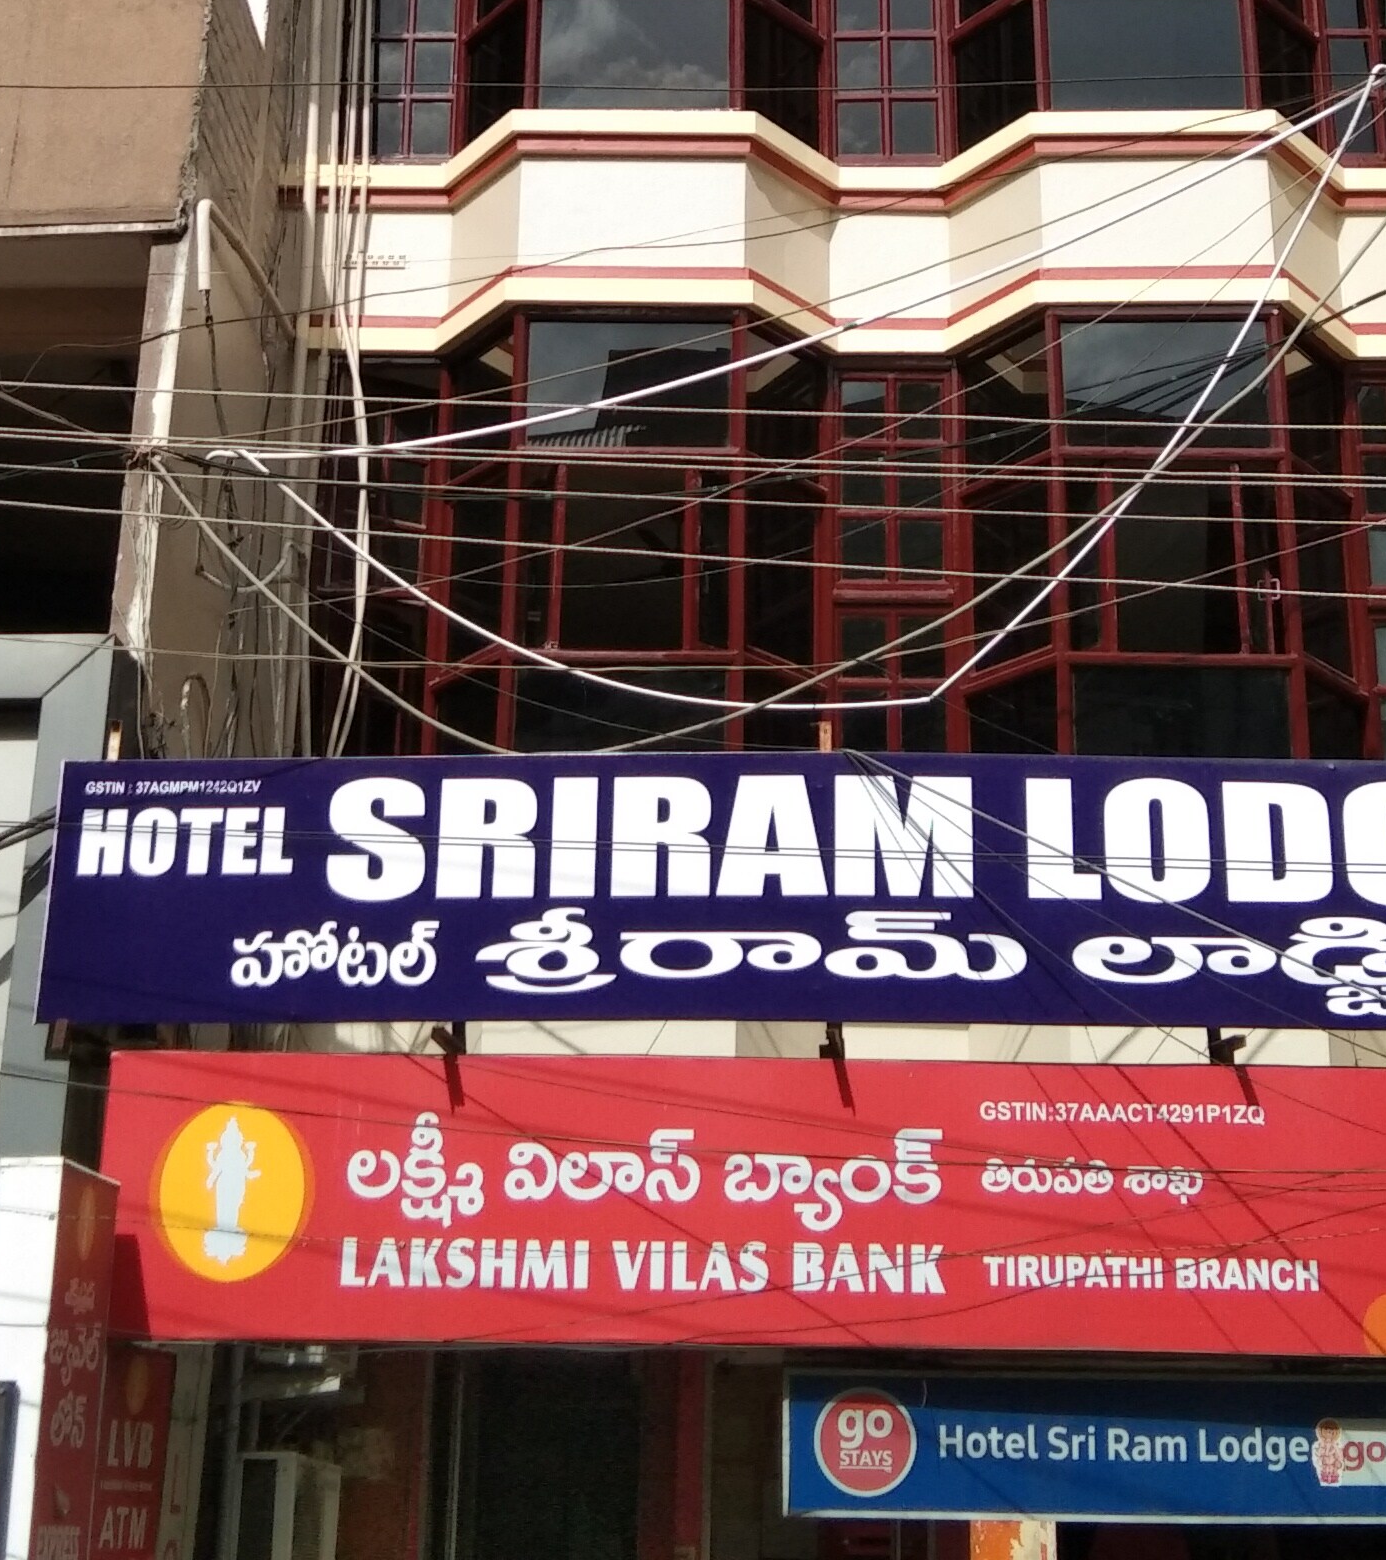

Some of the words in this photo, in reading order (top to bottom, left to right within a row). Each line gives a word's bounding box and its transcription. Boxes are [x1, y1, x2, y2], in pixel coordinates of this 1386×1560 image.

[85, 780, 125, 795] GSTIN
[76, 806, 294, 877] HOTEL
[326, 774, 974, 902] SRIRAM
[339, 1236, 590, 1290] LAKSHMI
[611, 1240, 769, 1292] VILAS
[792, 1242, 946, 1294] BANK
[982, 1255, 1164, 1289] TIRUPATHI
[1175, 1258, 1321, 1292] BRANCH
[106, 1419, 155, 1469] LVB
[837, 1408, 893, 1449] go
[939, 1424, 1038, 1459] Hotel
[1047, 1426, 1096, 1461] Sri
[1107, 1428, 1188, 1462] Ram
[1198, 1427, 1310, 1472] Lodge
[839, 1449, 893, 1467] STAYS
[98, 1505, 148, 1550] ATM
